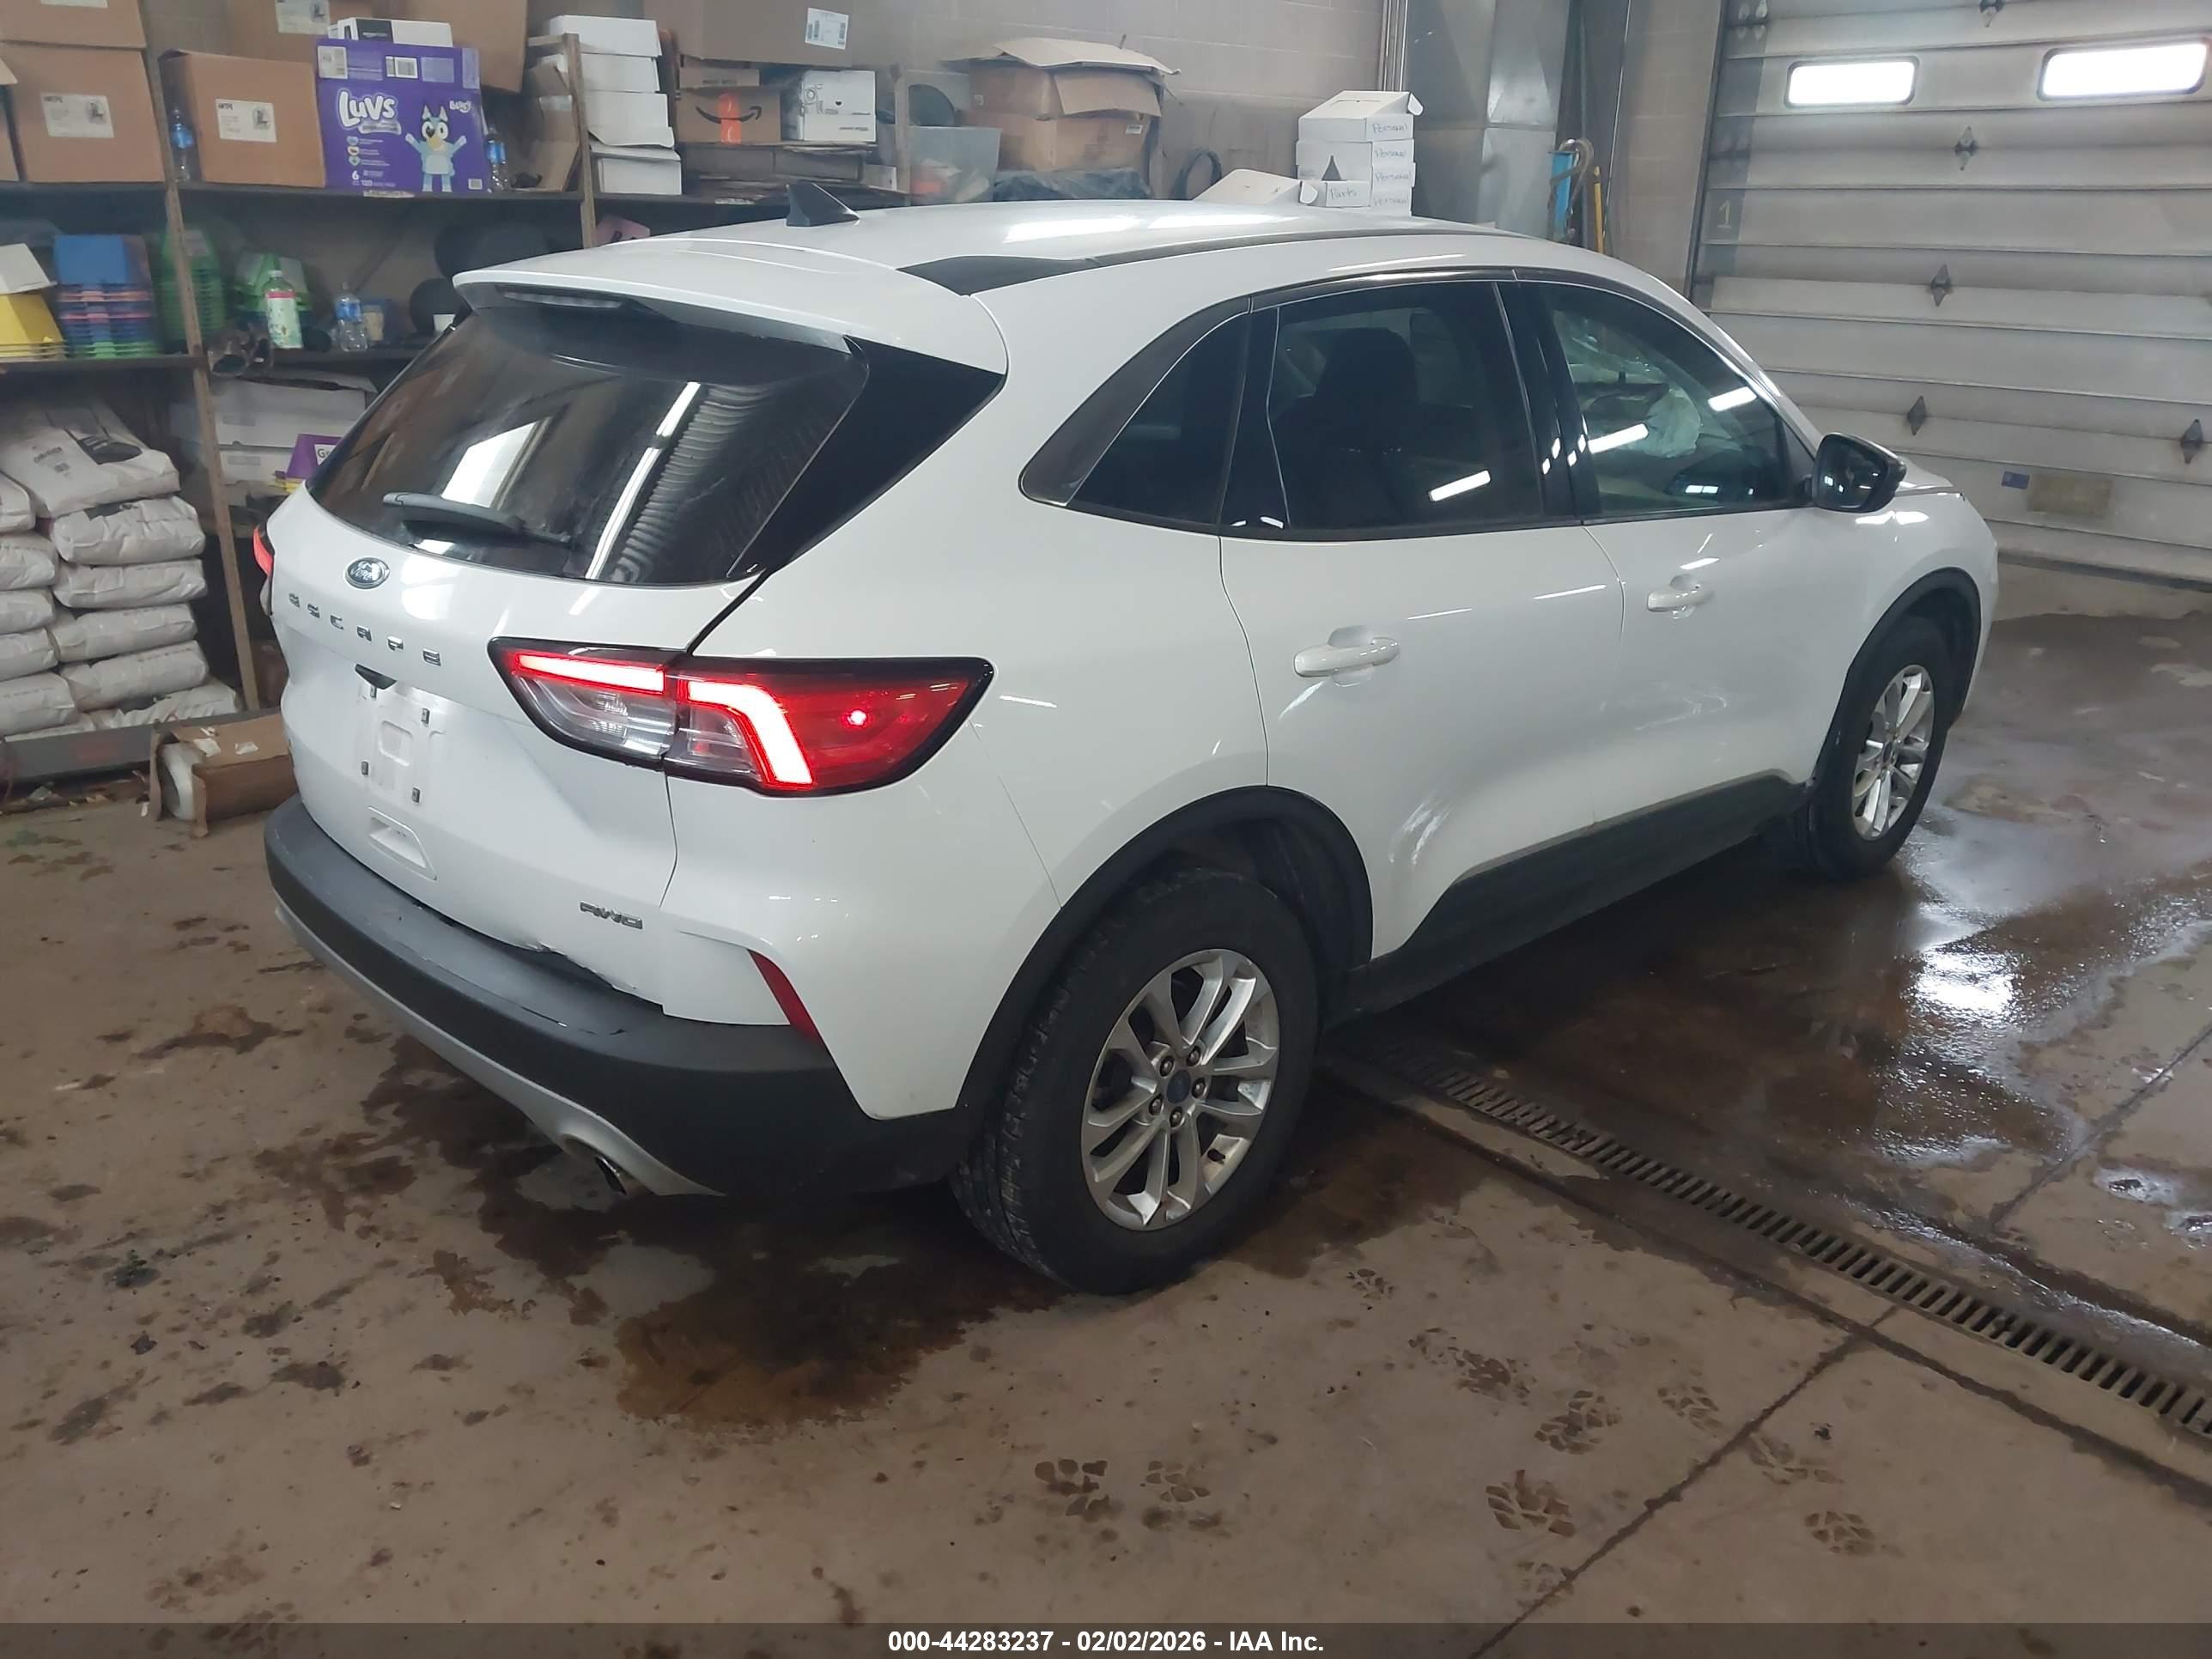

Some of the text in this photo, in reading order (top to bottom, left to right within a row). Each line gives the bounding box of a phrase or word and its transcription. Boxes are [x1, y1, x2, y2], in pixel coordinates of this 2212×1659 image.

[351, 170, 360, 180] 6
[1717, 200, 1732, 228] 1
[289, 592, 441, 667] ESCAPE
[580, 900, 643, 930] AWD
